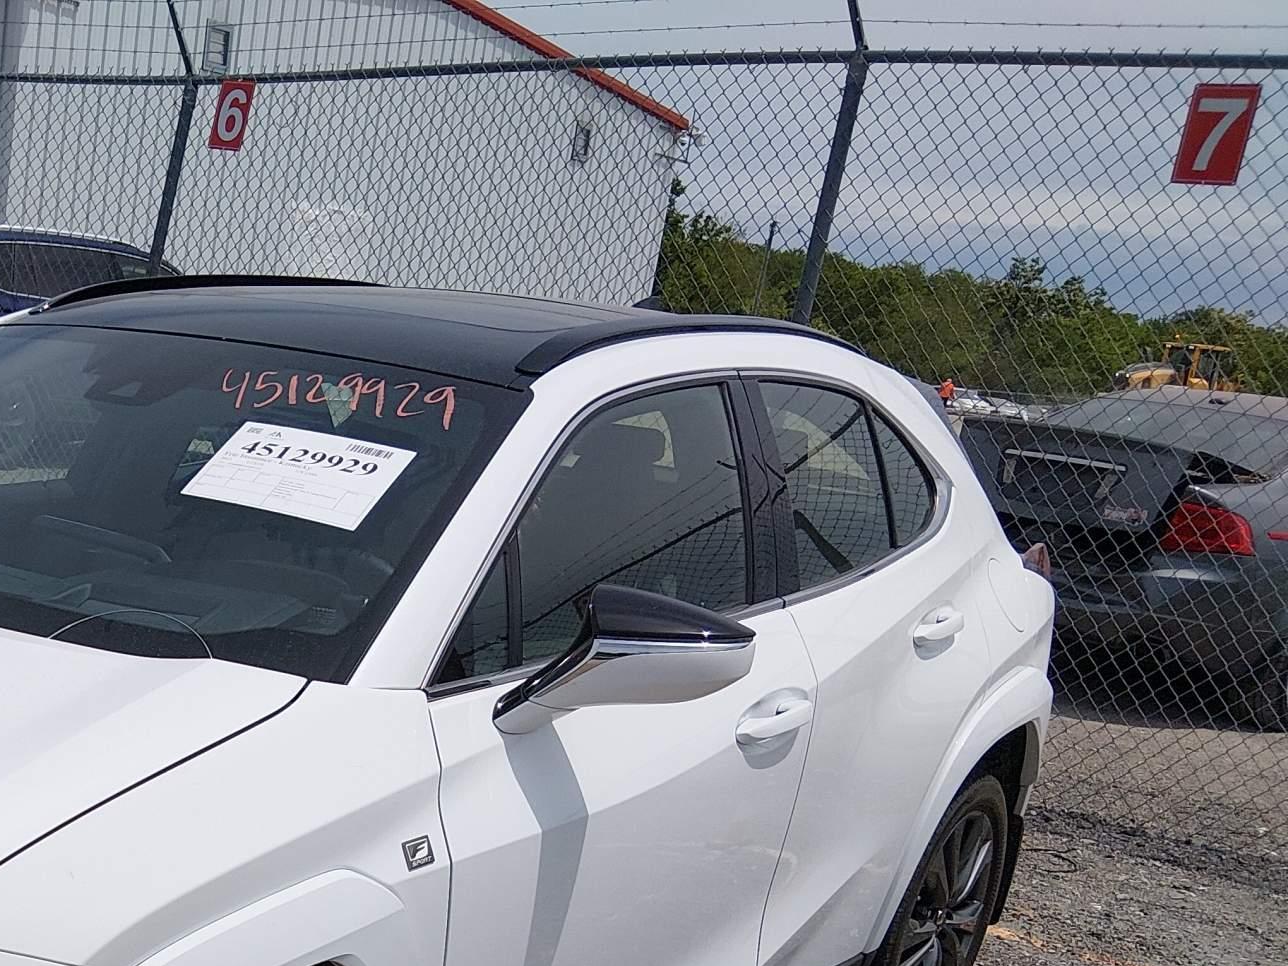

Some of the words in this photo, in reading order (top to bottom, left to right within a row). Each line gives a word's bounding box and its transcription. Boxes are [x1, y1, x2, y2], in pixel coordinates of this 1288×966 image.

[217, 88, 247, 142] 6
[1192, 97, 1250, 171] 7
[221, 367, 457, 431] 45129929
[240, 440, 379, 477] 45129929
[411, 855, 433, 868] SPORT
